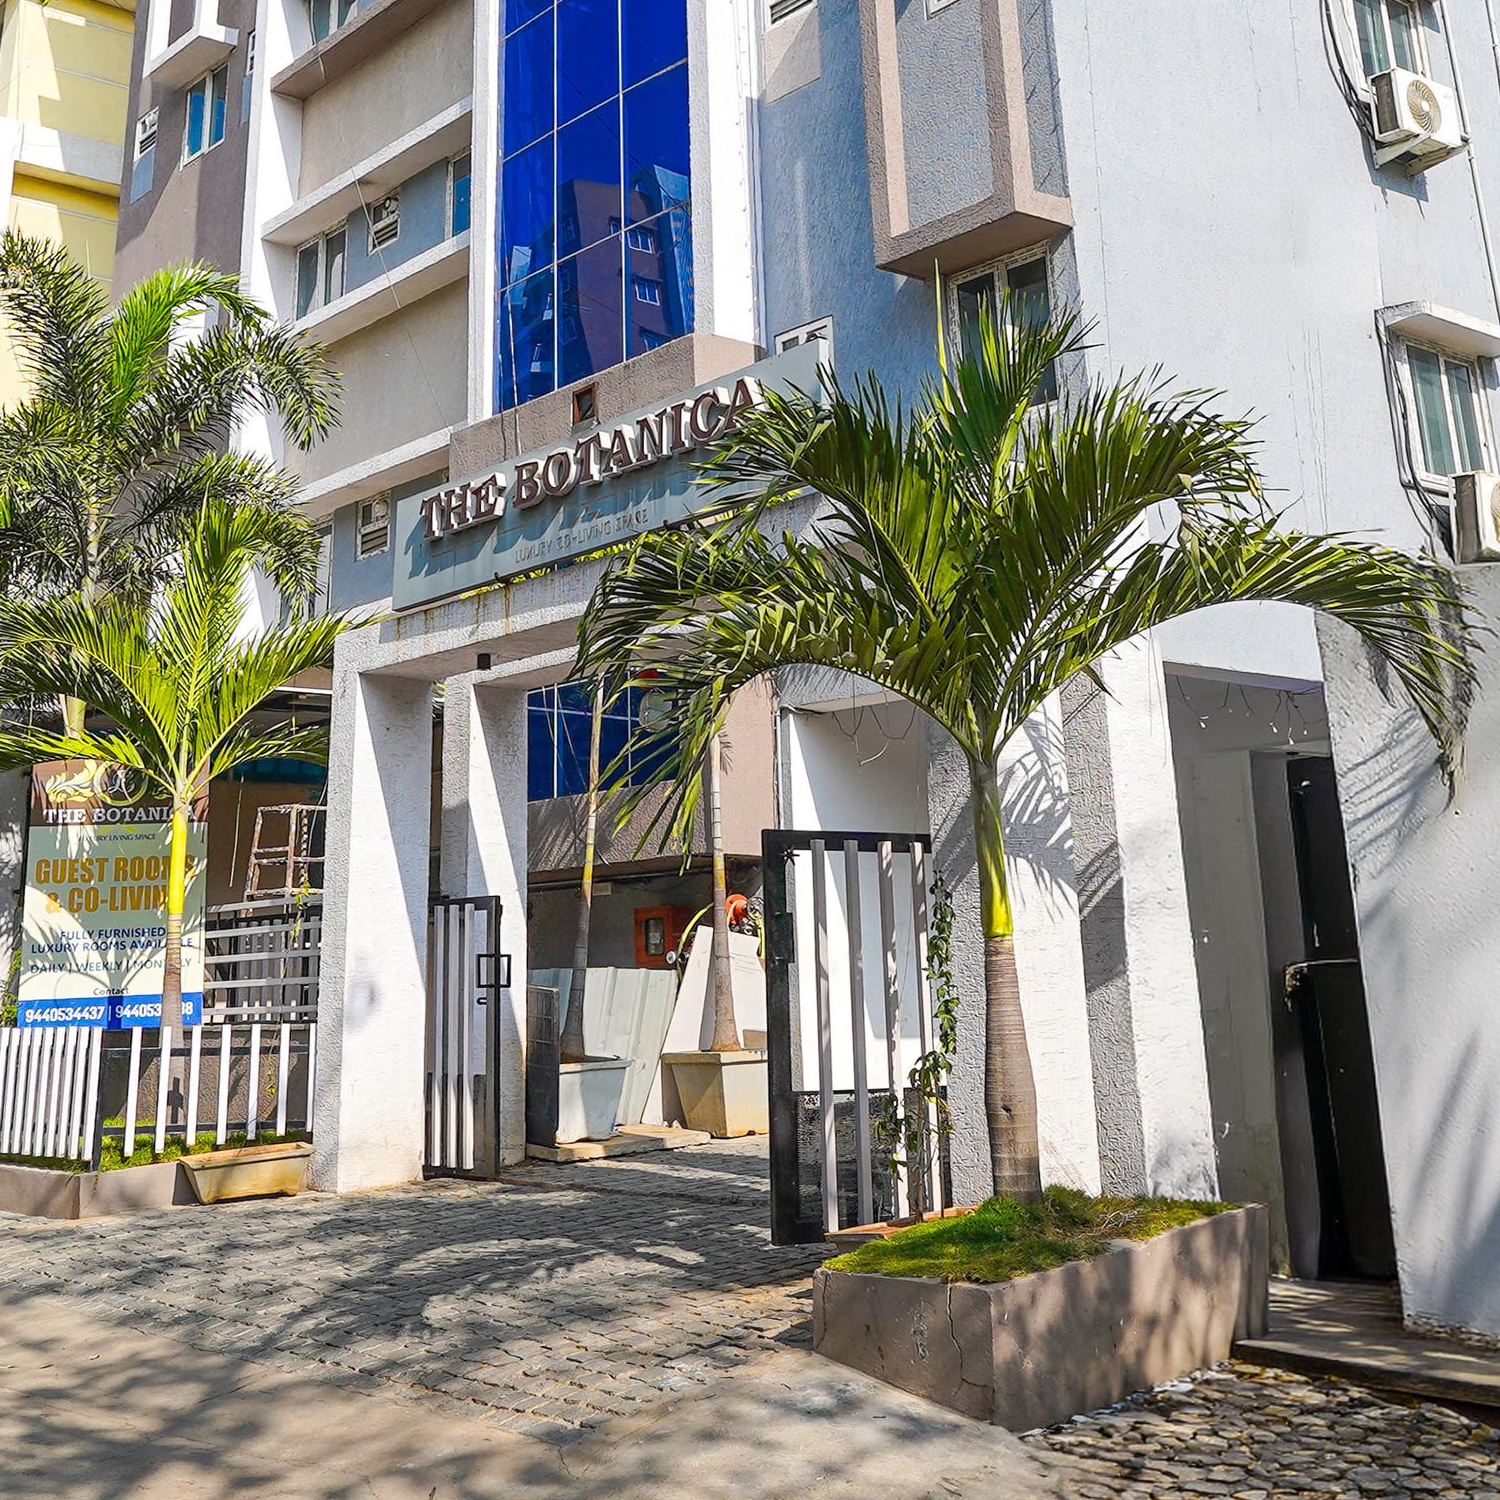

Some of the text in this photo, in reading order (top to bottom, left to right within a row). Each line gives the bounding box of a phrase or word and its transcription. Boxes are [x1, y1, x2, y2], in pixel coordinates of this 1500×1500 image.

[420, 376, 764, 541] THE BOTANICA
[515, 508, 649, 564] LUXURY CO-LIVING SPACE
[43, 806, 198, 823] THE BOTANIA
[109, 833, 133, 842] LIVING
[35, 856, 109, 885] GUEST
[67, 885, 168, 914] CO-LIVIN
[59, 927, 166, 940] FULLY FURNISHED
[31, 937, 193, 954] LUXURY ROOMS AVAILLE
[30, 958, 192, 974] DAILY WEEKLY MONLY
[93, 987, 129, 996] Contact
[25, 1001, 194, 1023] 9440534437 9440538
